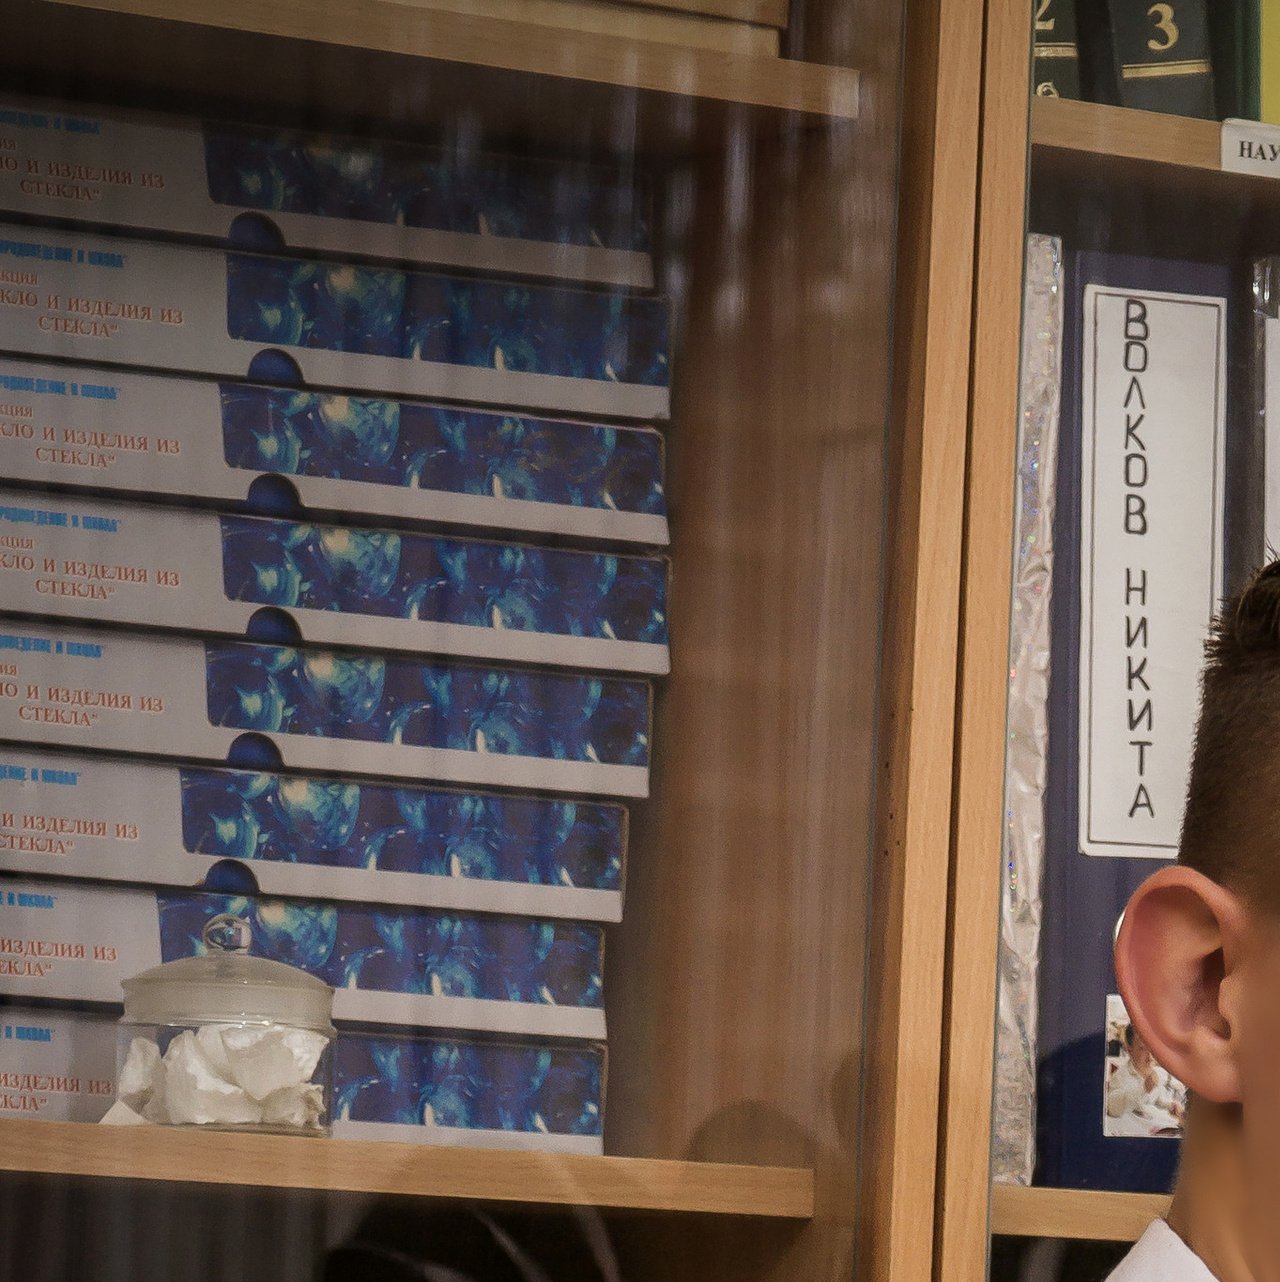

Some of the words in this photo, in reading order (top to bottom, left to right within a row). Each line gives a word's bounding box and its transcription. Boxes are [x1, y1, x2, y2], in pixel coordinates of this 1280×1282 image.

[1146, 2, 1180, 51] 3
[27, 158, 39, 174] И
[48, 161, 133, 186] ИЗДЕЛИЯ
[141, 173, 166, 189] ИЗ
[46, 294, 59, 311] И
[67, 297, 152, 321] ИЗДЕЛИЯ
[160, 308, 184, 325] ИЗ
[1123, 299, 1149, 536] ВОЛКОВ
[42, 427, 55, 442] И
[63, 428, 149, 452] ИЗДЕЛИЯ
[157, 438, 181, 455] ИЗ
[43, 558, 56, 573] И
[64, 560, 149, 584] ИЗДЕЛИЯ
[156, 571, 181, 587] ИЗ
[27, 685, 39, 700] И
[48, 687, 133, 711] ИЗДЕЛИЯ
[140, 696, 164, 713] ИЗ
[1124, 567, 1155, 819] НИКИТА
[1, 813, 15, 828] И
[22, 814, 107, 837] ИЗДЕЛИЯ
[115, 824, 139, 840] ИЗ
[0, 938, 85, 960] ИЗДЕЛИЯ
[93, 945, 118, 962] ИЗ
[88, 1079, 113, 1096] ИЗ
